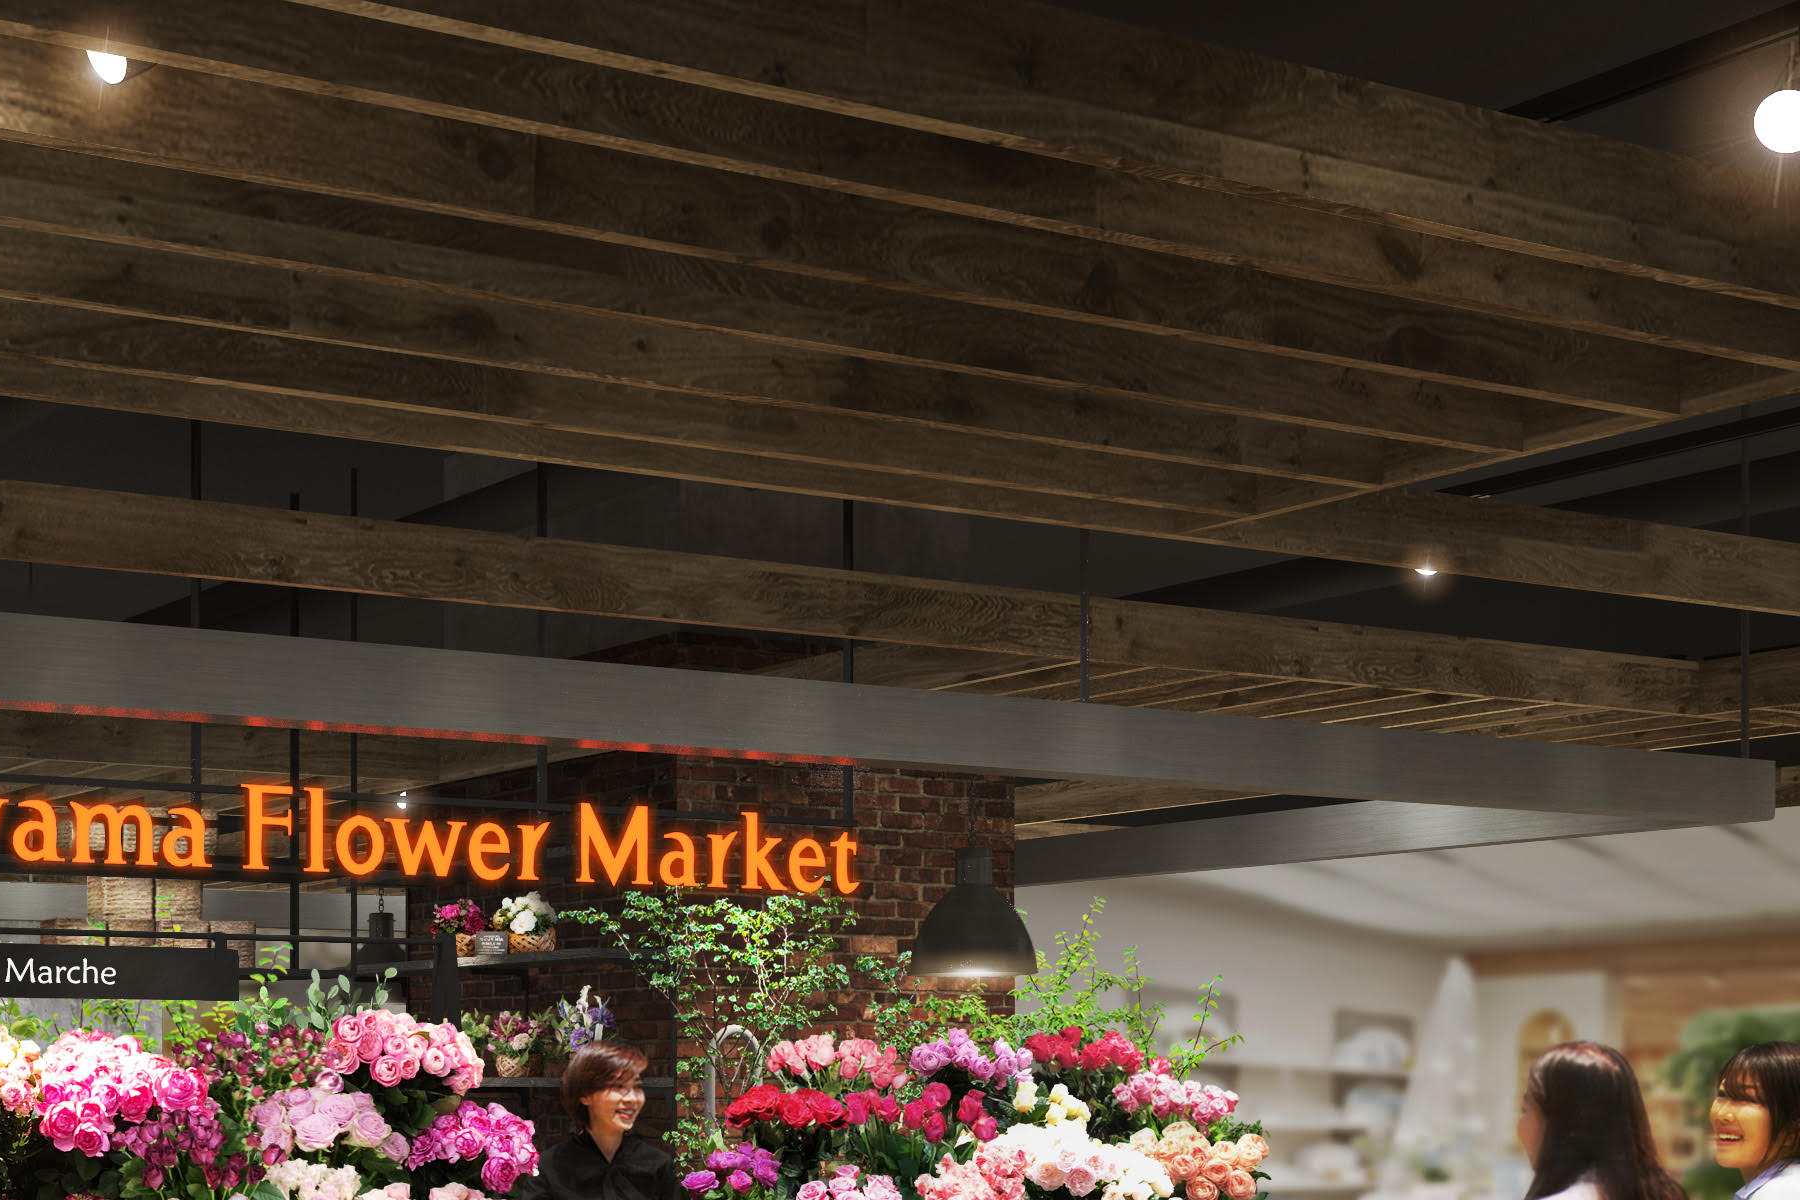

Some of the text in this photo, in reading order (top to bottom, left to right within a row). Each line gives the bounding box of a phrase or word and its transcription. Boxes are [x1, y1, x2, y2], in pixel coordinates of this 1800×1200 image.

[240, 783, 550, 881] Flower
[575, 802, 860, 894] Market
[4, 957, 117, 985] Marche
